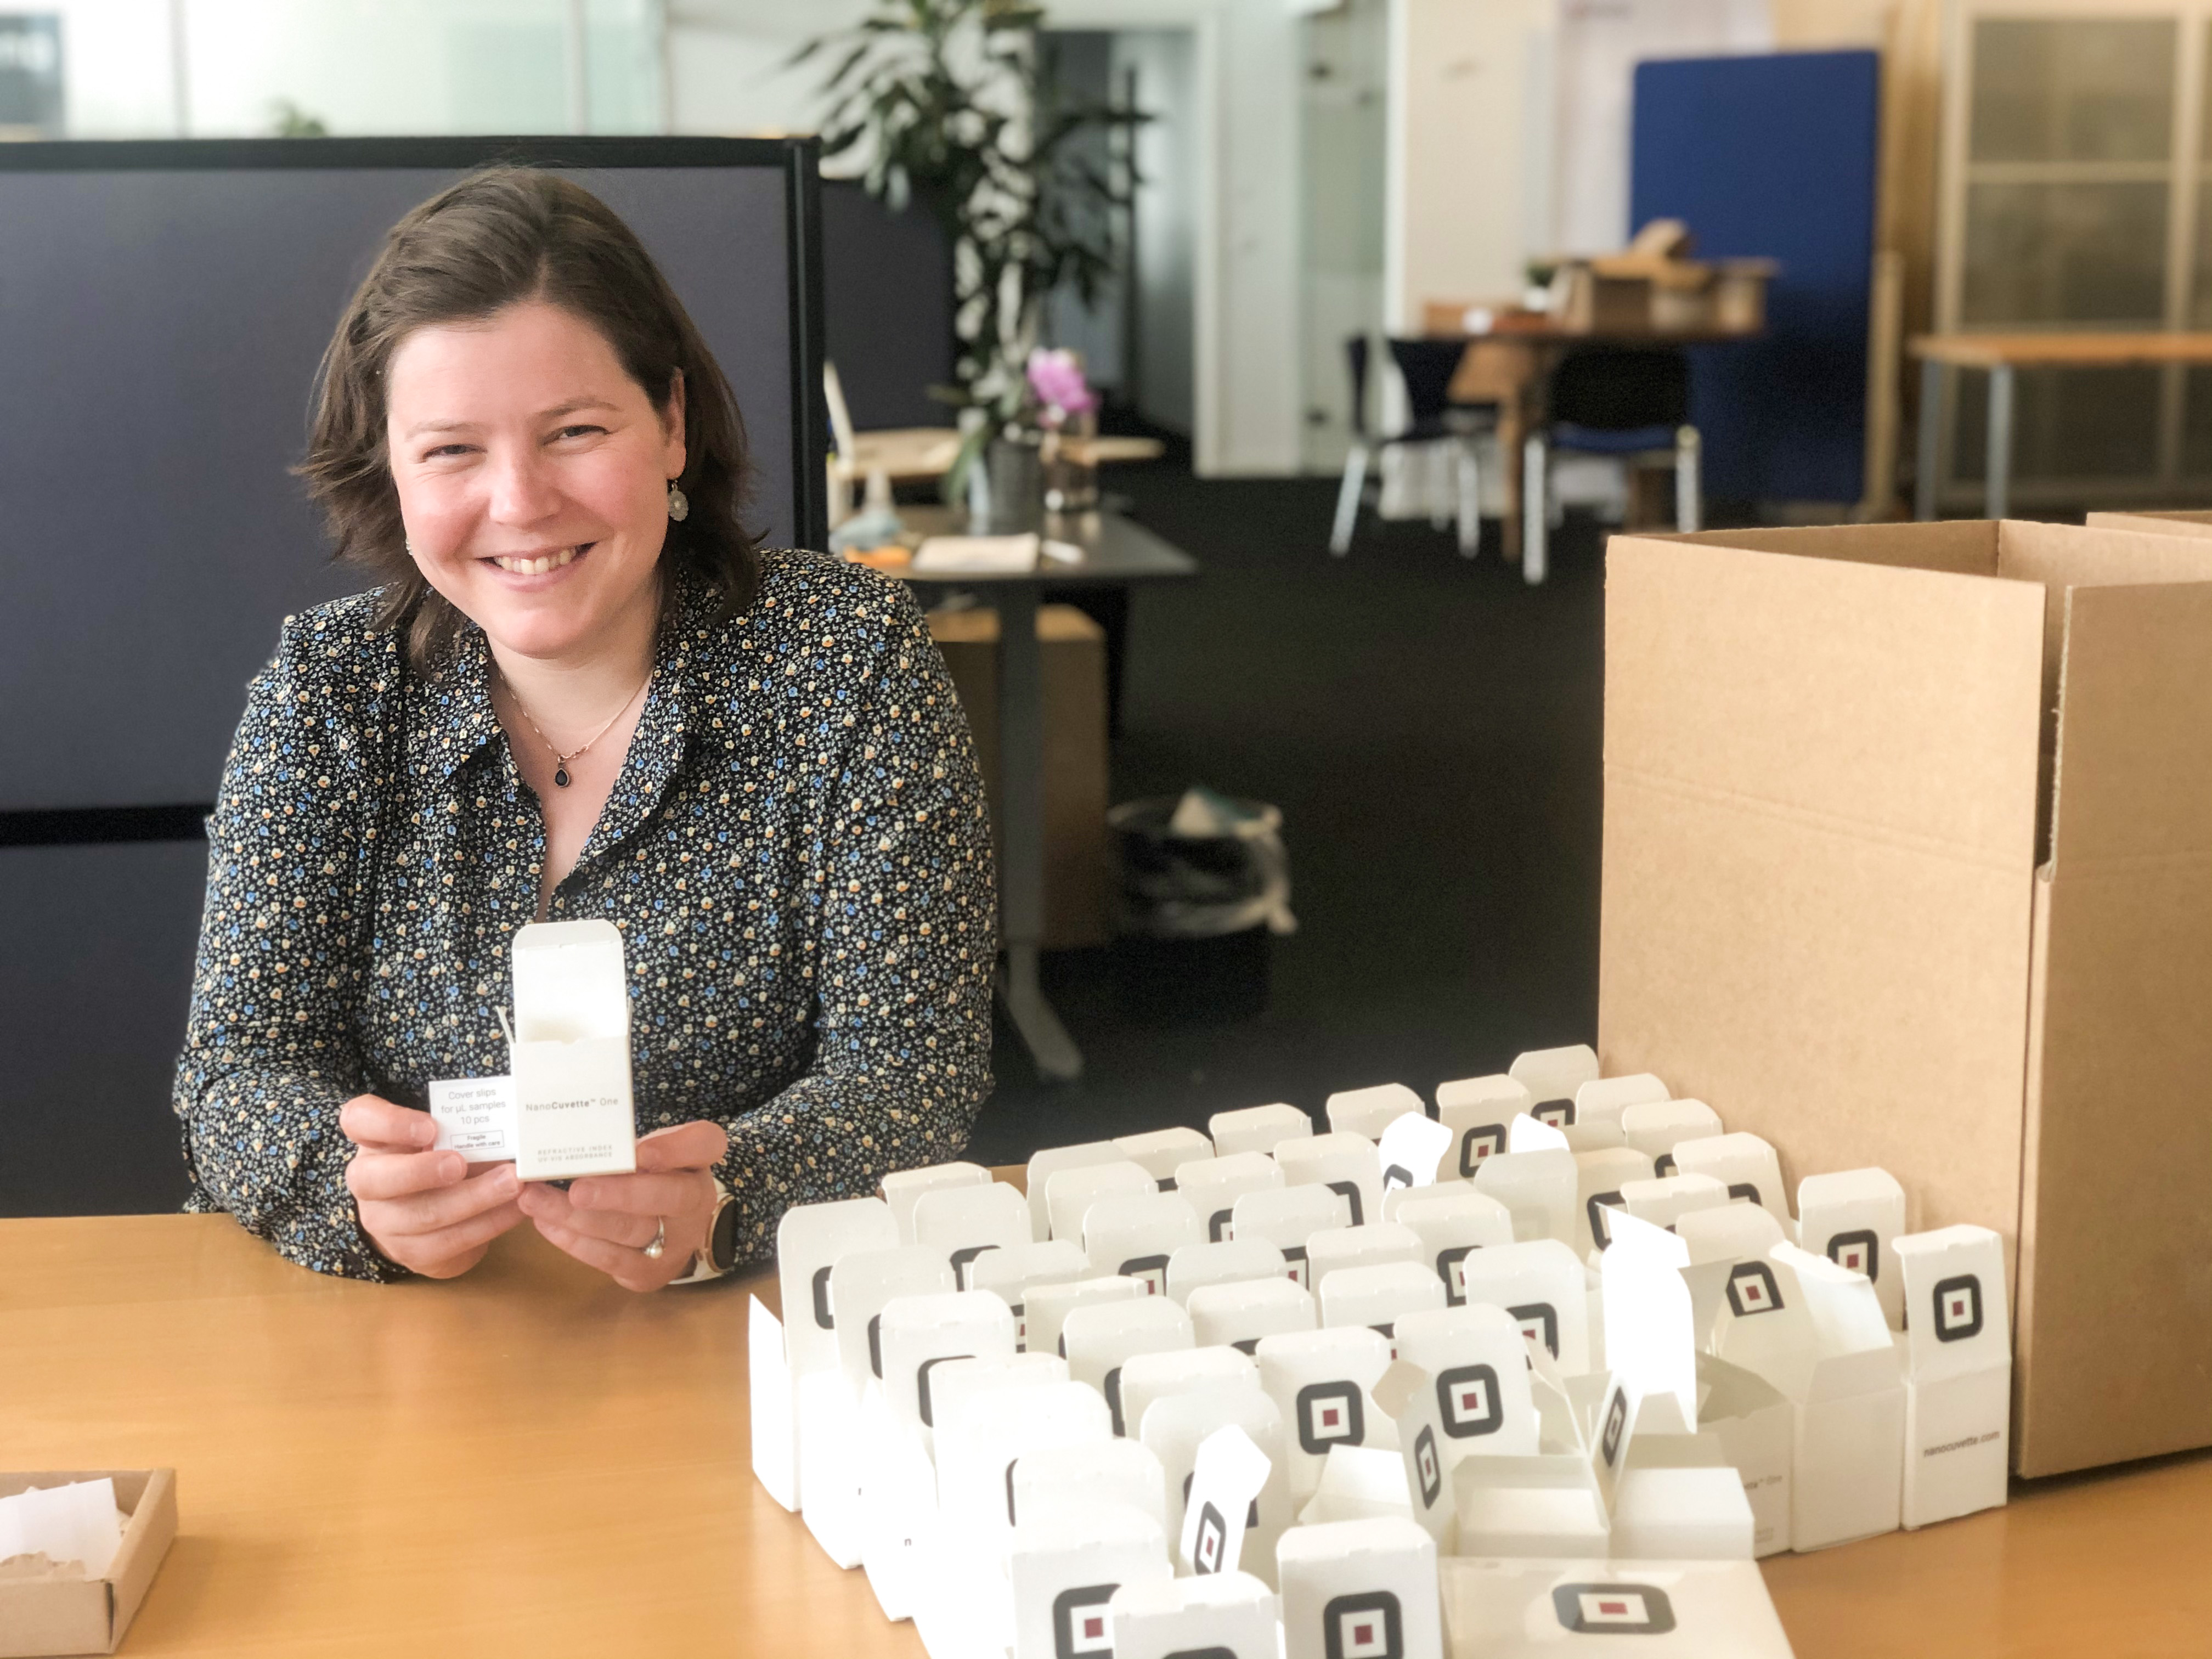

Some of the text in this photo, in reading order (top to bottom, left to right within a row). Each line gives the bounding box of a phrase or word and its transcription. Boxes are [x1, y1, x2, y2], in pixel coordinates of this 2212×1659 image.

[448, 1088, 496, 1100] Cover slips
[600, 1098, 618, 1106] One
[441, 1105, 453, 1113] for
[469, 1101, 506, 1110] samples
[461, 1116, 489, 1125] 10 pcs
[538, 1147, 585, 1155] REFRACTIVE
[566, 1152, 612, 1161] ABSORBANCE
[1923, 1430, 2000, 1457] nanocuvette.com
